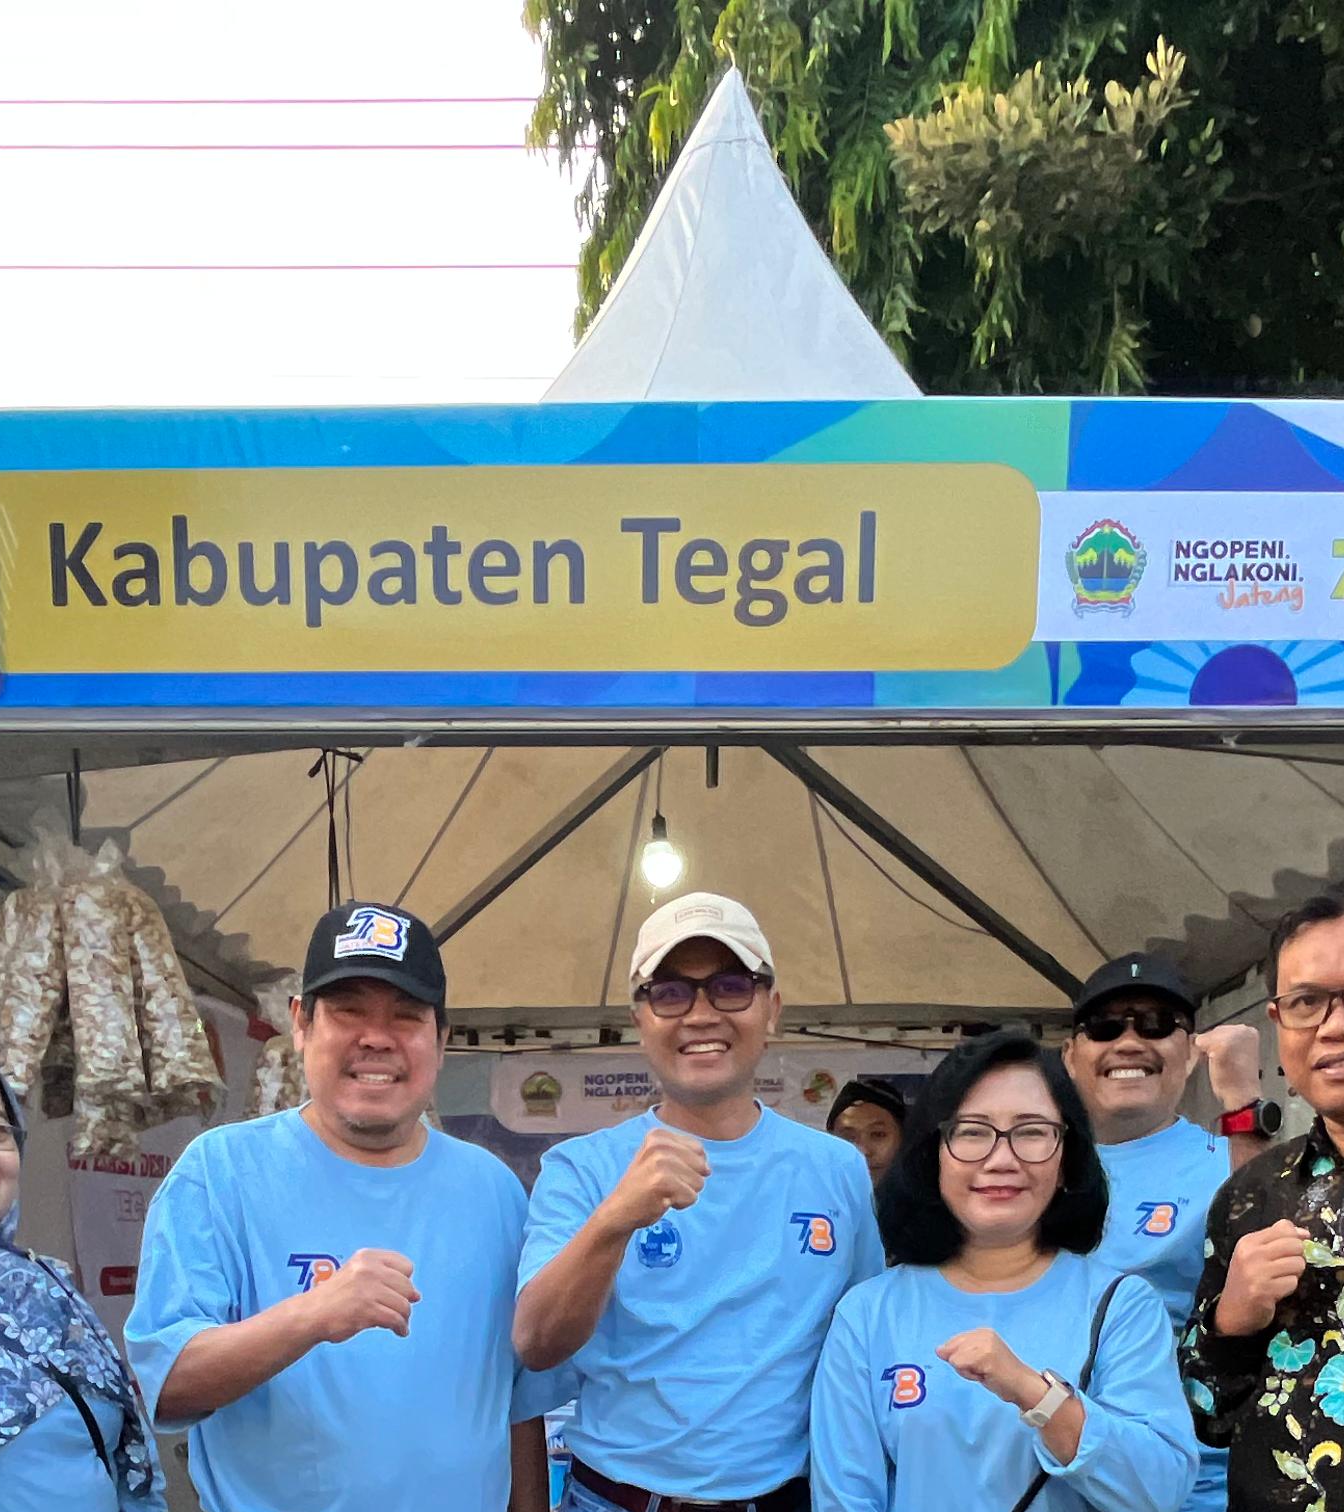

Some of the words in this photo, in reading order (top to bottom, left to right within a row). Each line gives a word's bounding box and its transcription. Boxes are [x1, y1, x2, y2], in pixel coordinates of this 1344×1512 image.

[1174, 540, 1291, 559] NGOPENI.
[49, 514, 586, 628] Kabupaten
[619, 510, 877, 627] Tegal
[1173, 563, 1304, 582] NGLAKONI.
[1217, 578, 1304, 611] Jateng
[789, 1212, 837, 1256] 78
